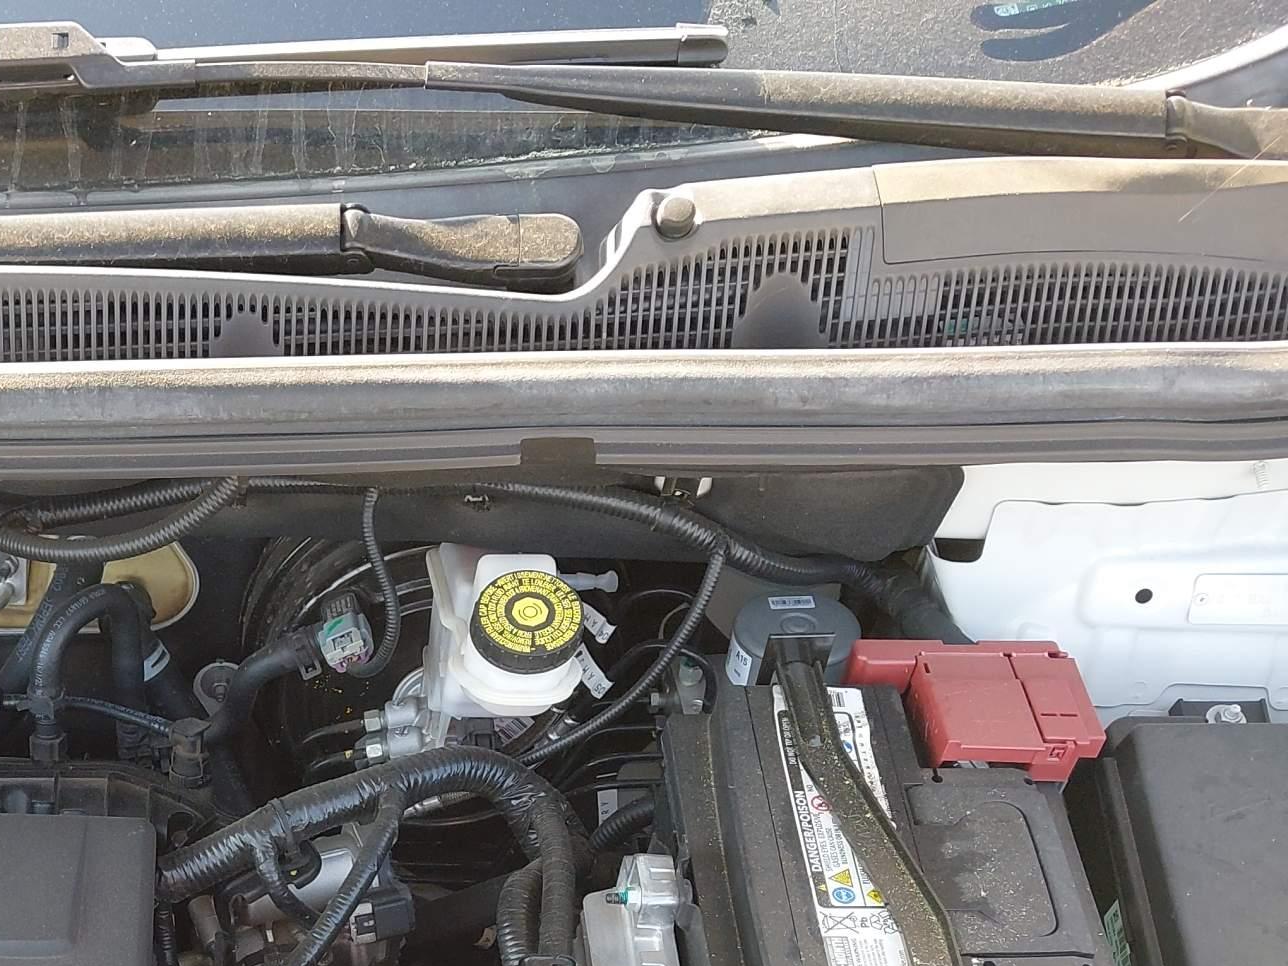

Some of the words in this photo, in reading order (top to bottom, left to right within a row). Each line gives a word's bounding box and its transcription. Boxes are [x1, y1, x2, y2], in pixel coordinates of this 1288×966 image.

[735, 650, 749, 666] A15
[793, 790, 823, 872] DANGER/POISON
[860, 916, 870, 928] Pb
